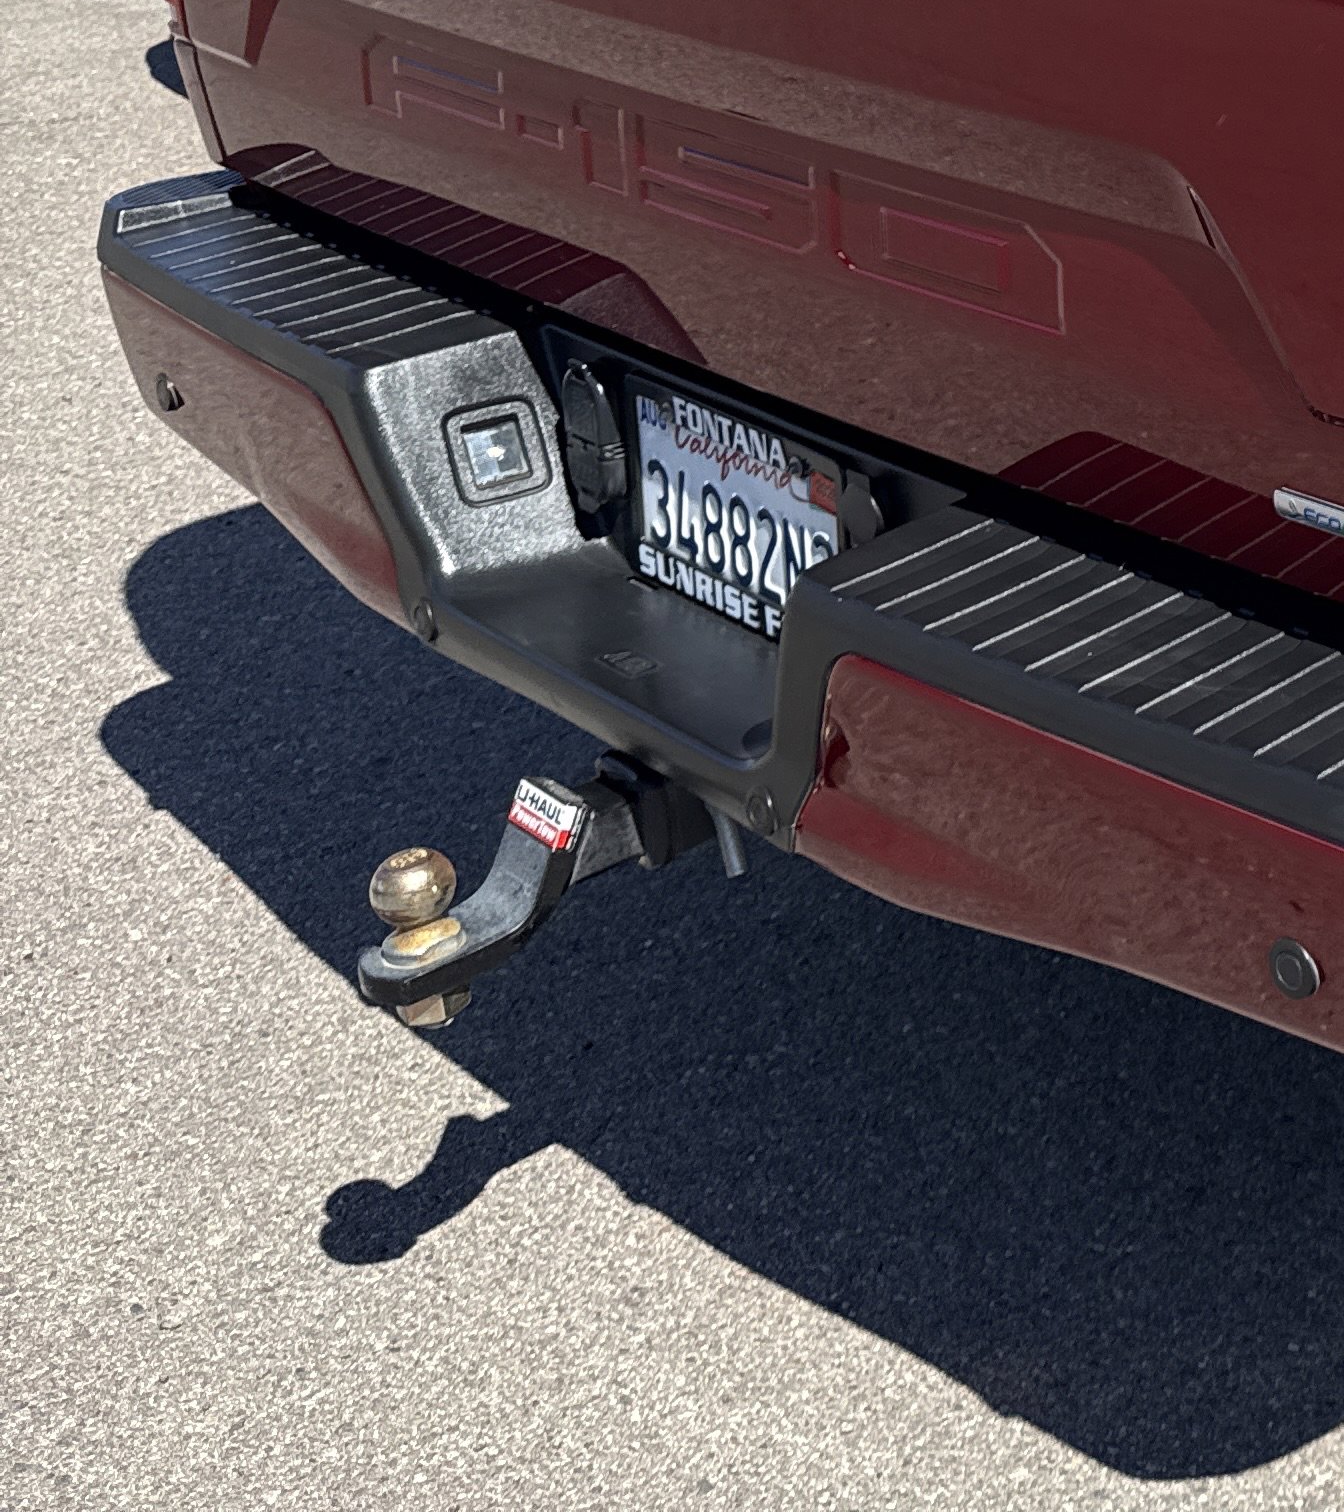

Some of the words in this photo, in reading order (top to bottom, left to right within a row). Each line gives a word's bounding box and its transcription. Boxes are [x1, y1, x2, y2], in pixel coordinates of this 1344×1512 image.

[361, 34, 1065, 336] F-150
[672, 396, 786, 471] FONTANA
[638, 543, 761, 629] SUNRISE
[517, 784, 562, 826] U-HAUL
